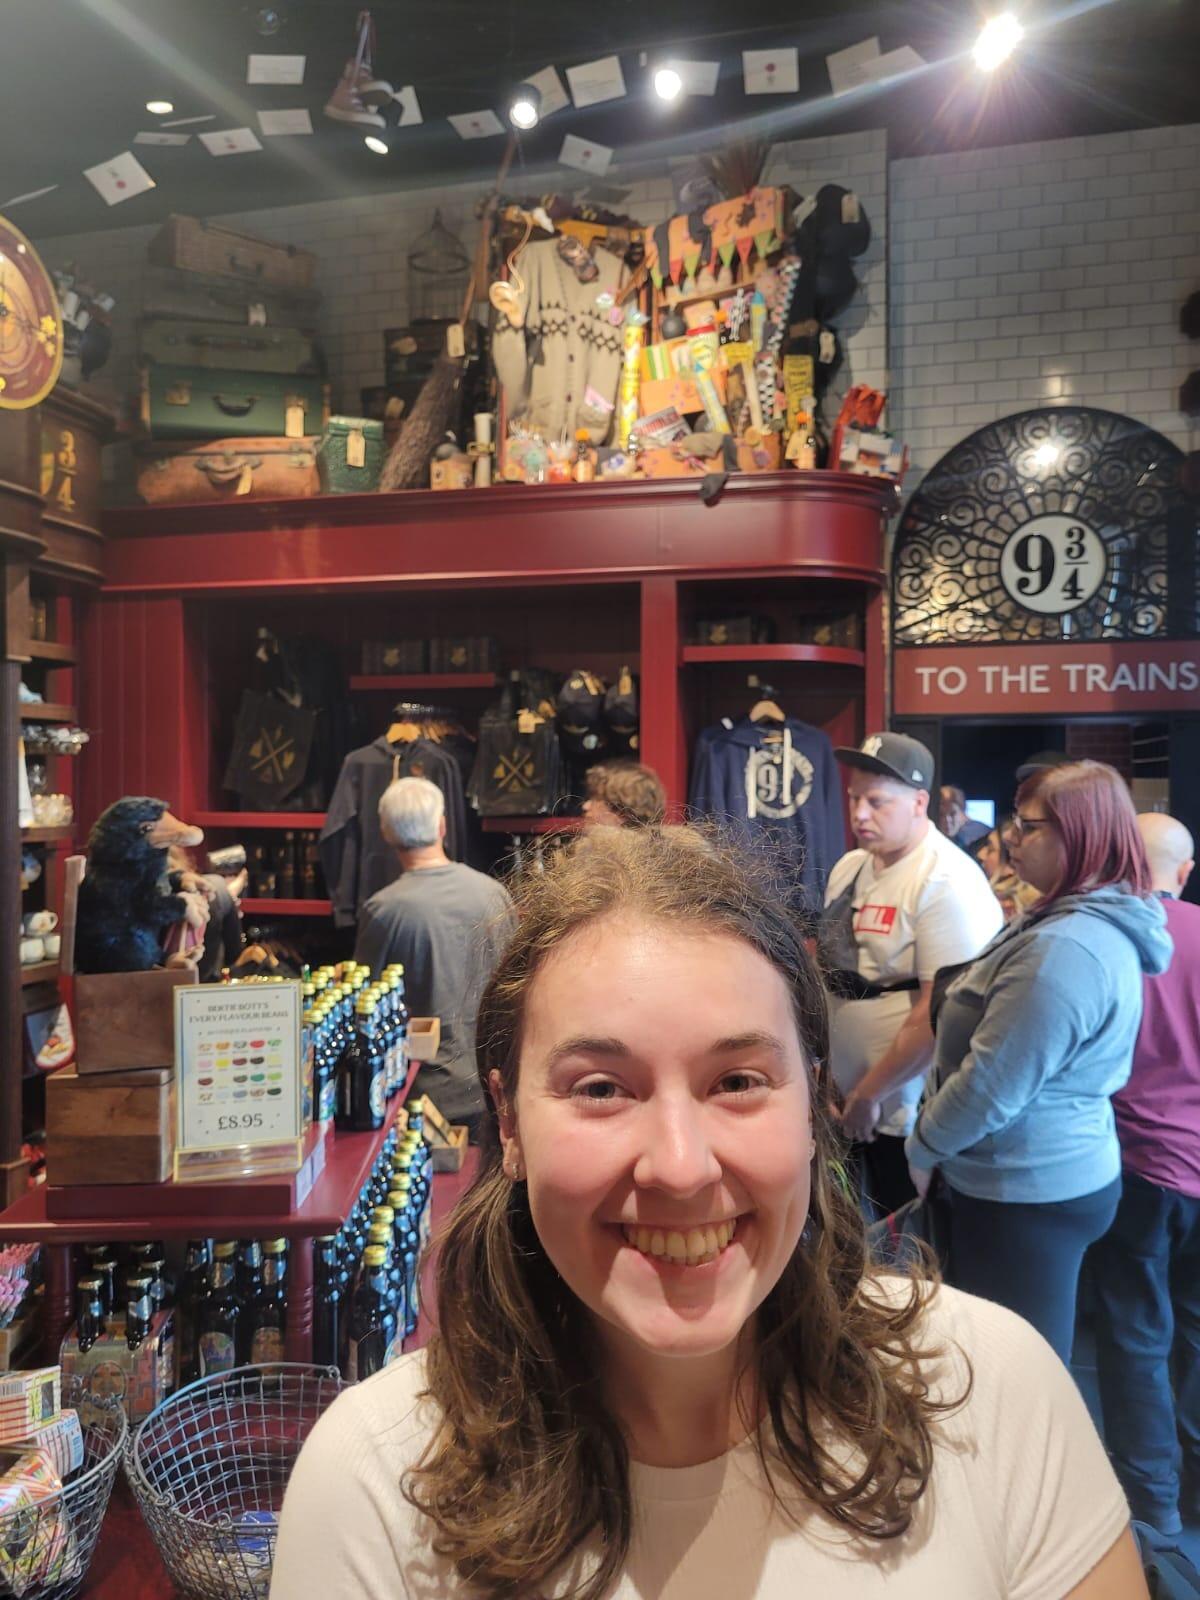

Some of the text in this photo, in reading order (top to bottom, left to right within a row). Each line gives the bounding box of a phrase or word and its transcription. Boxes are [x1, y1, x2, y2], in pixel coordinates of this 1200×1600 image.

[915, 661, 1199, 695] TO THE TRAINS
[189, 1013, 217, 1023] EVERY
[219, 1012, 259, 1022] FLAVOUR
[218, 1113, 263, 1130] £8.95
